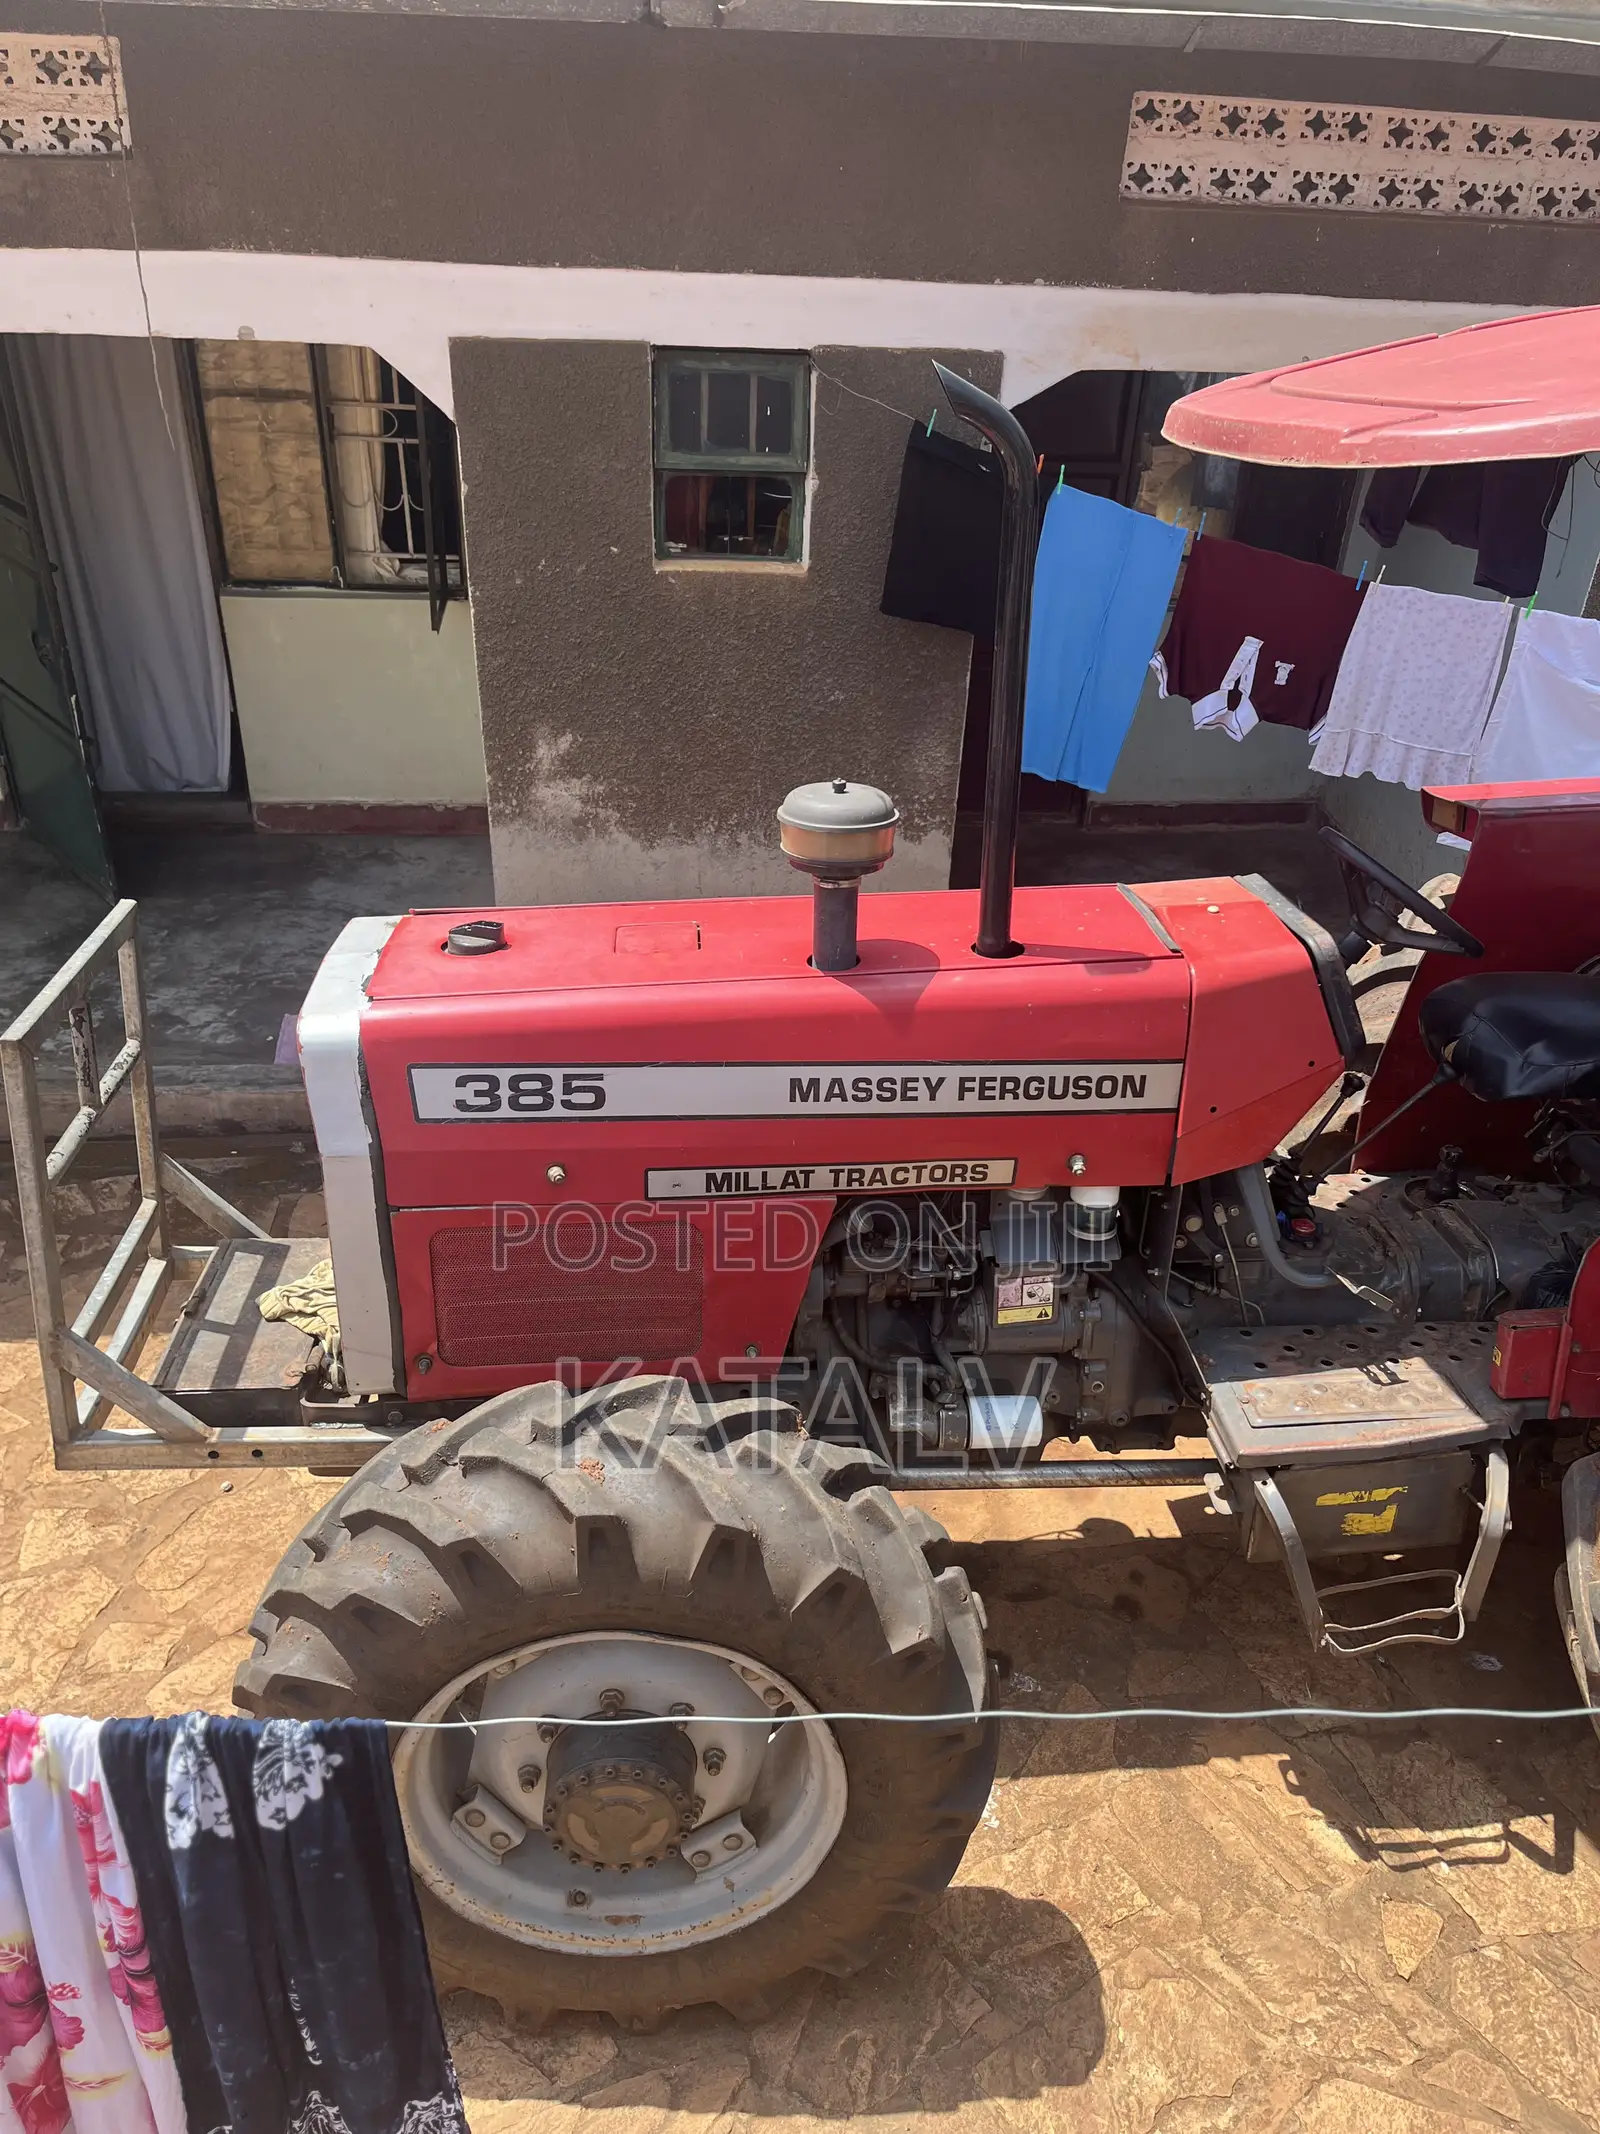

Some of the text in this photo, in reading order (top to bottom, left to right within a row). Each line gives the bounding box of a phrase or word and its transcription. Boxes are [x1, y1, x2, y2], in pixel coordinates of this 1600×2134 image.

[454, 1073, 607, 1112] 385
[789, 1074, 1147, 1103] MASSEY FERGUSON
[705, 1163, 989, 1194] MILLAT TRACTORS
